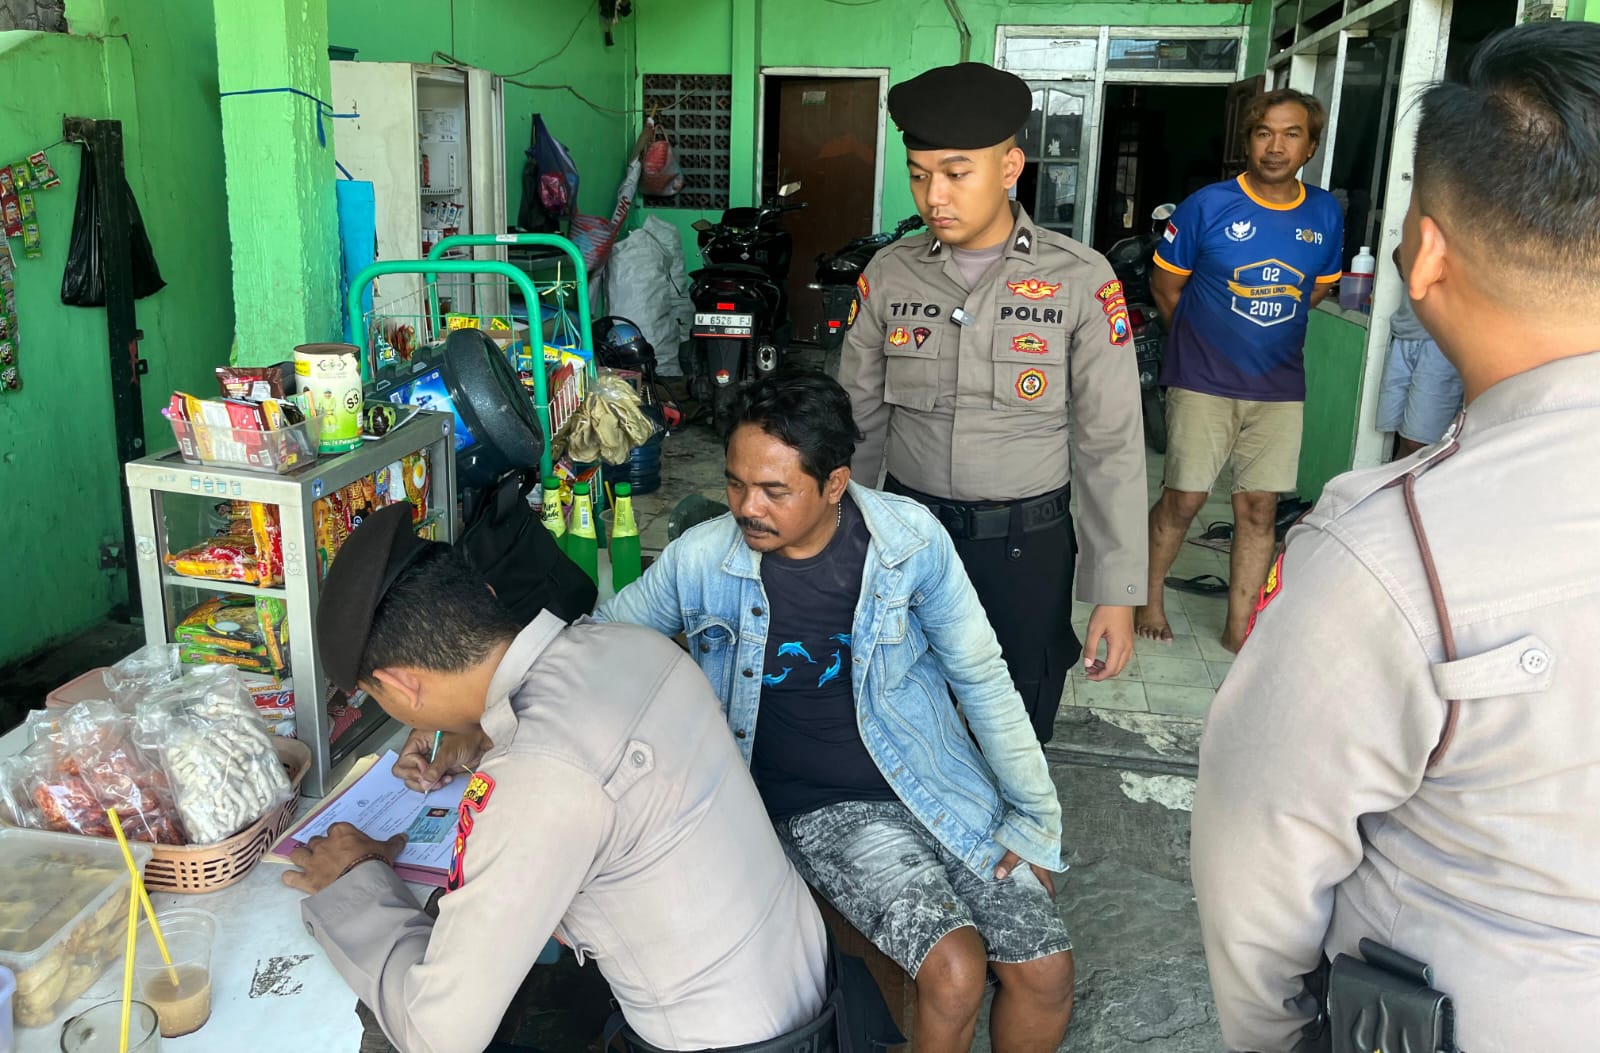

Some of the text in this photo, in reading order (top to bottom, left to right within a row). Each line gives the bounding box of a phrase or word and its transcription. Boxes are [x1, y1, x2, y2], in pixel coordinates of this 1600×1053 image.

[1262, 267, 1280, 282] 02
[1250, 287, 1271, 296] SANDI
[890, 302, 942, 318] TITO
[1000, 306, 1063, 324] POLRI
[1249, 300, 1282, 318] 2019
